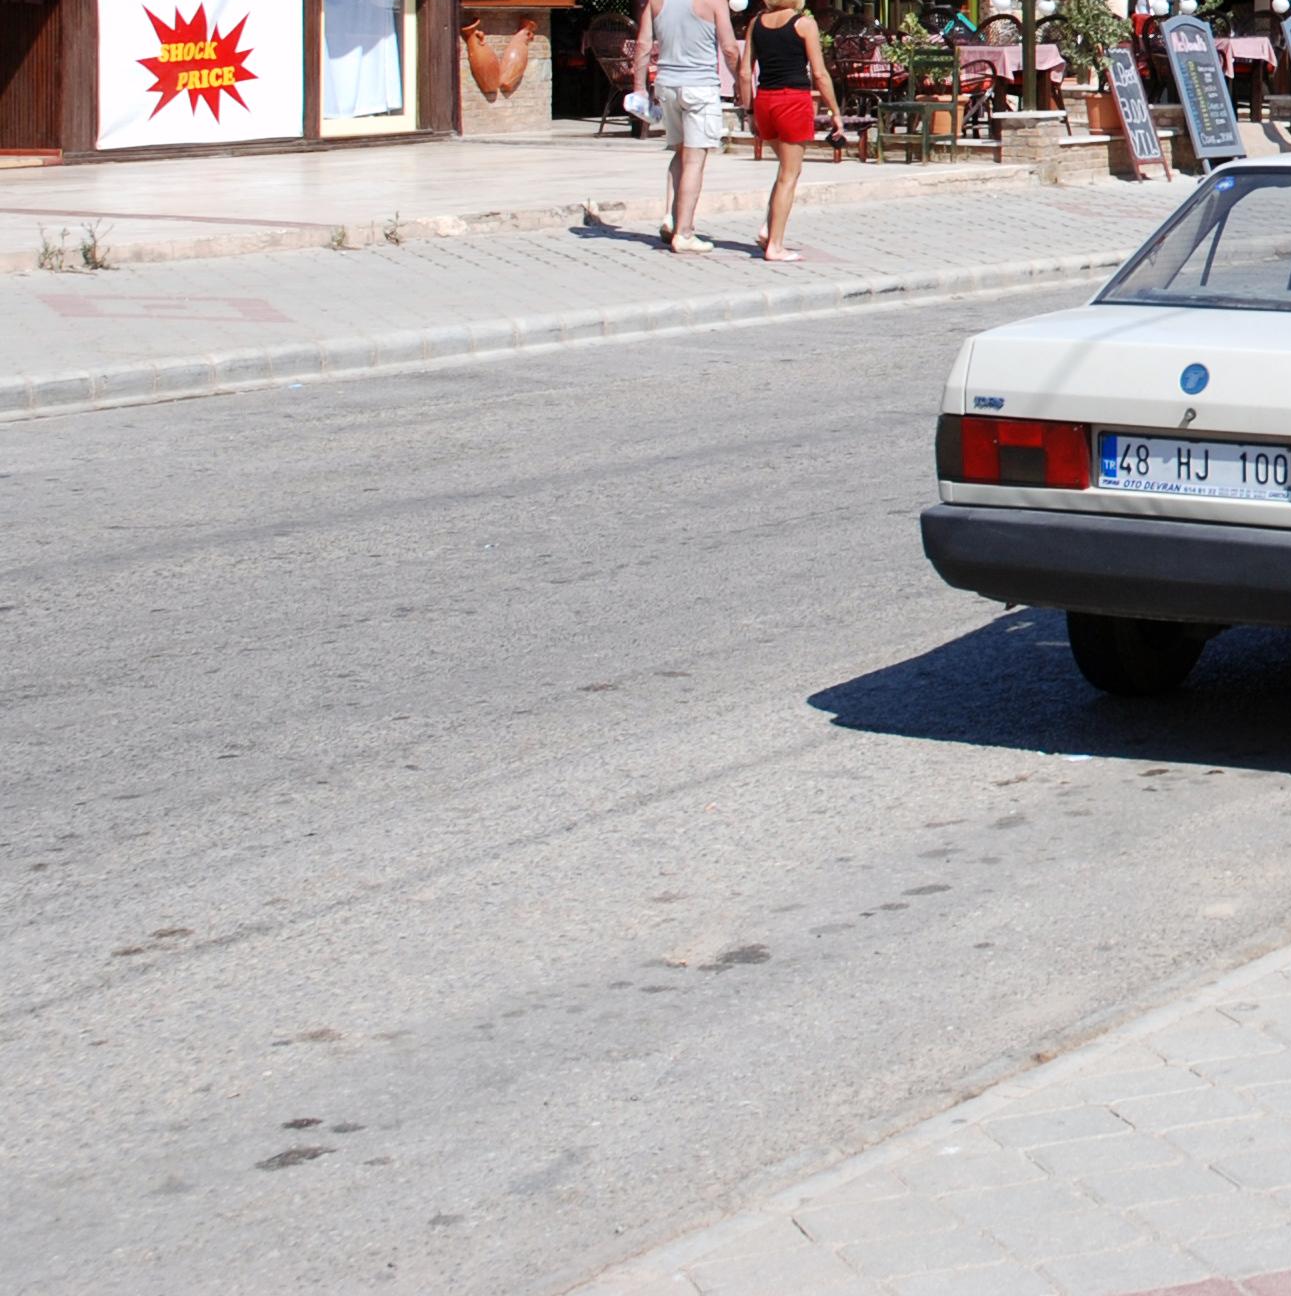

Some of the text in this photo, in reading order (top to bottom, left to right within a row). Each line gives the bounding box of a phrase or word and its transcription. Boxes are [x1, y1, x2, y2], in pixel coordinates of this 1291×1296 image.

[159, 41, 218, 63] SHOCK
[176, 66, 236, 91] PRICE
[1104, 459, 1117, 470] TR
[1119, 444, 1289, 486] 48 HJ 100
[1123, 479, 1142, 489] OTO
[1144, 480, 1181, 493] DEVRAN
